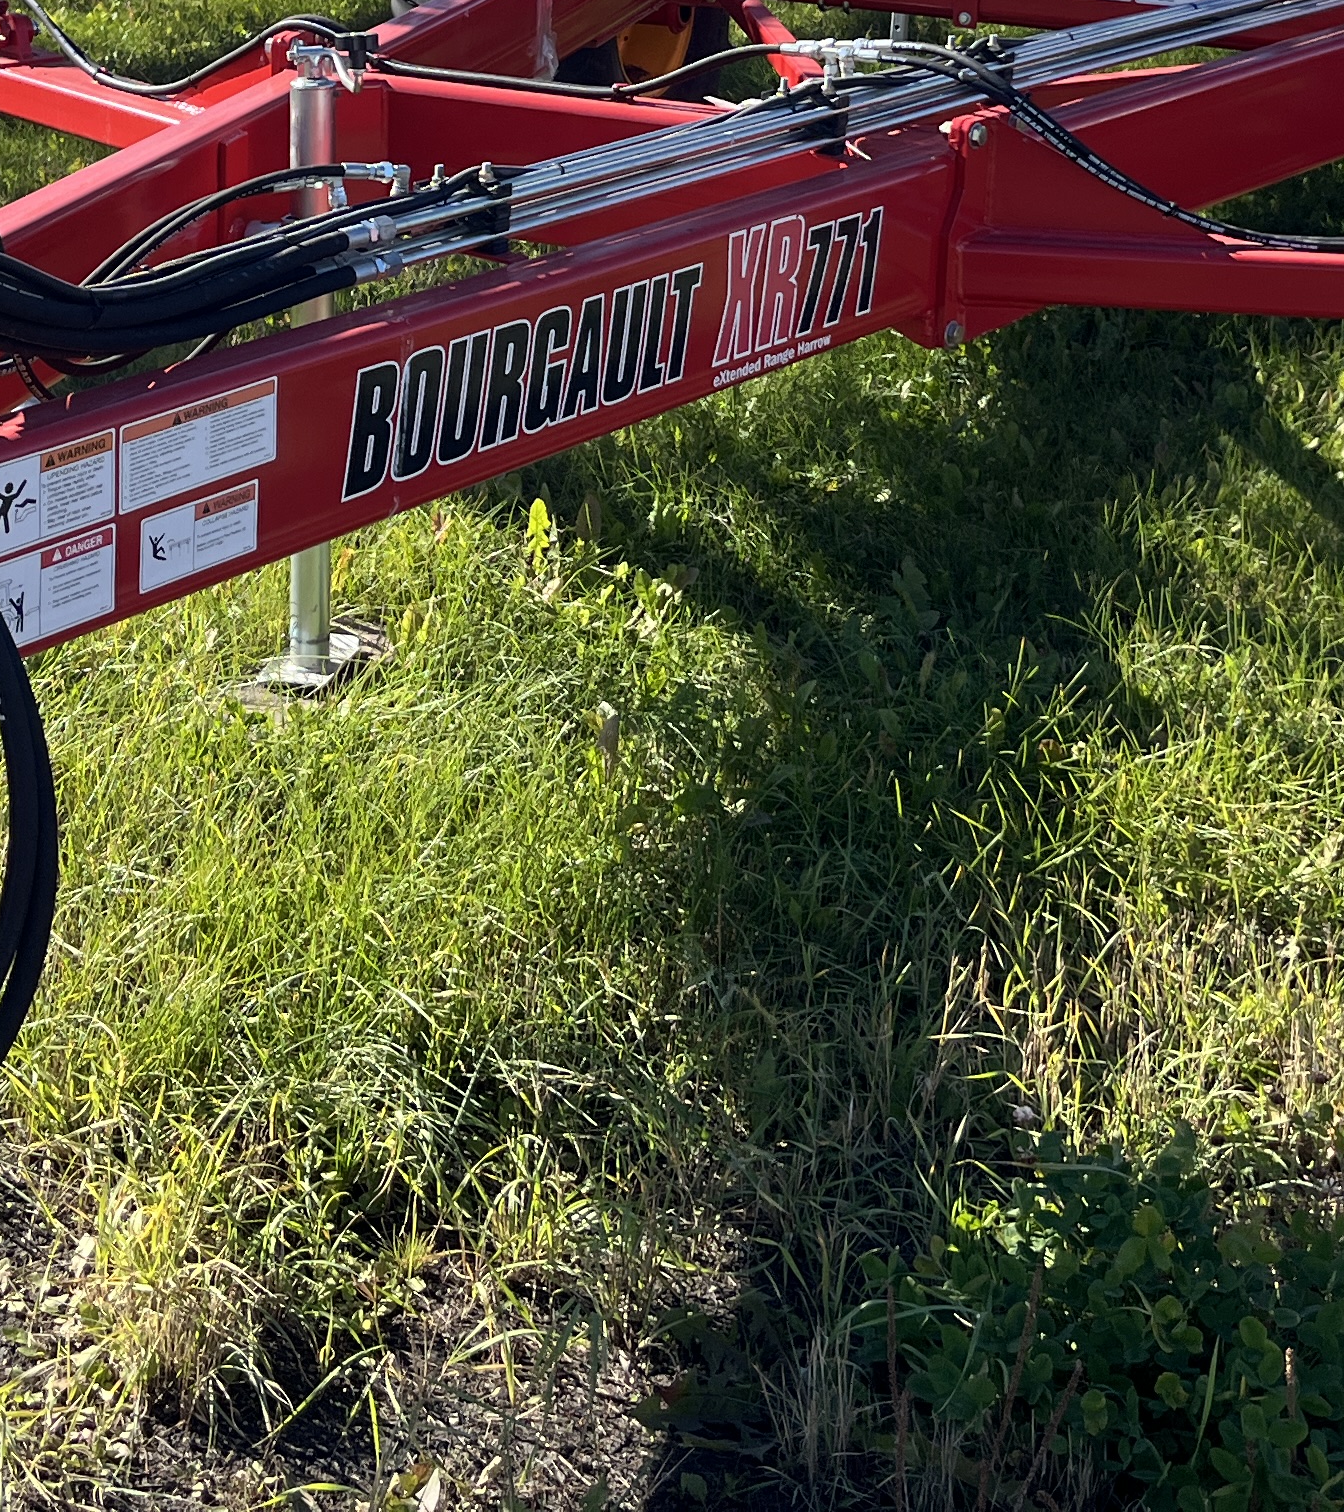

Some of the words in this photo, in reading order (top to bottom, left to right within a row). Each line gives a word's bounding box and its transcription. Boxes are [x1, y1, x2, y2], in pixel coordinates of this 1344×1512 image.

[341, 263, 703, 503] BOURGAULT
[712, 205, 885, 368] XR771
[713, 357, 761, 388] eXtended
[764, 348, 795, 368] Range
[797, 335, 831, 356] Harrow
[183, 398, 228, 420] WARNING
[57, 439, 105, 462] WARNING
[213, 489, 250, 510] WARNING
[65, 535, 103, 557] DANGER
